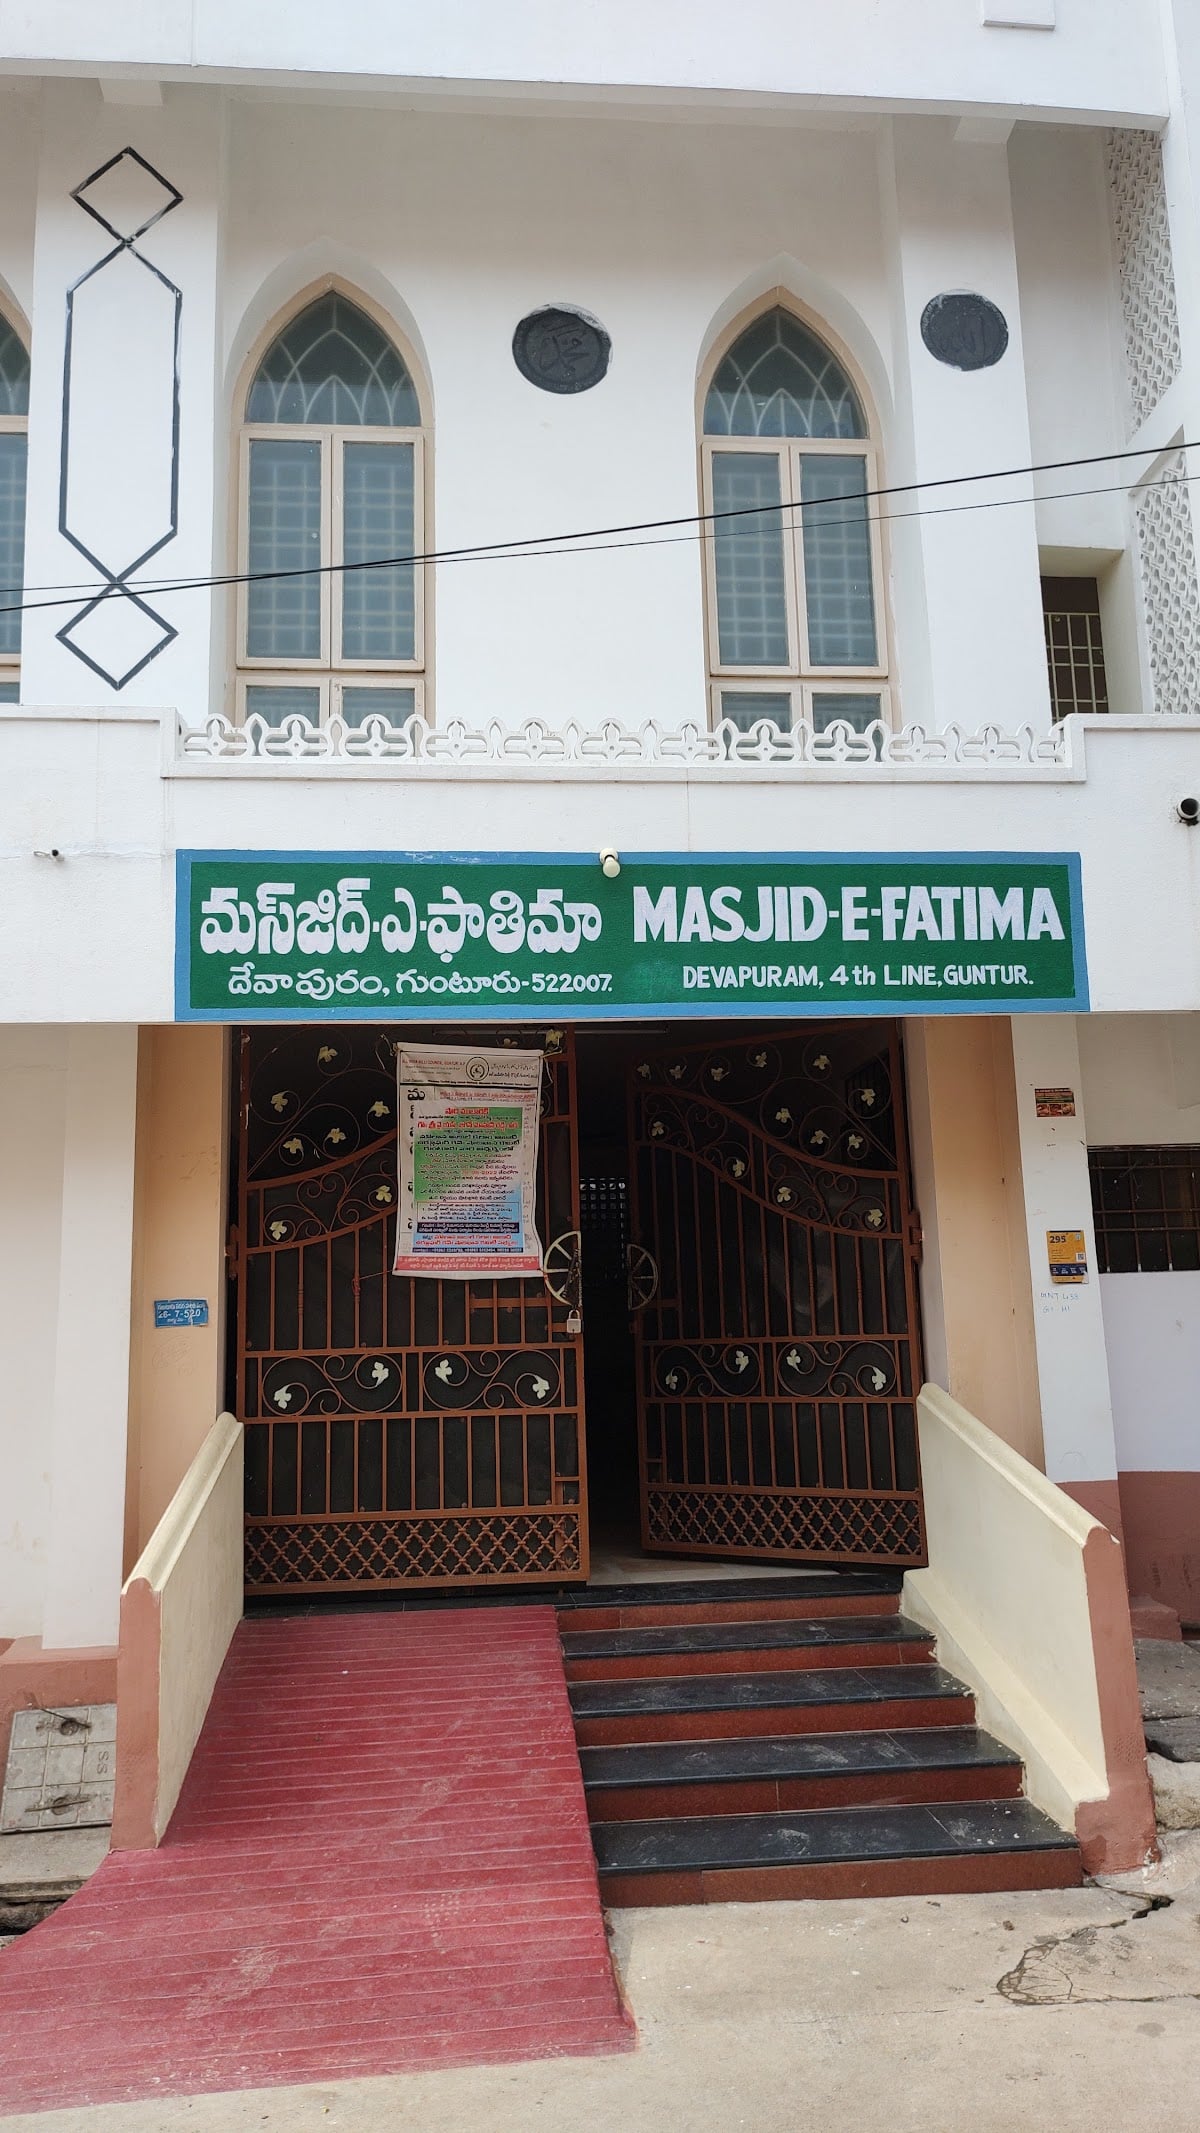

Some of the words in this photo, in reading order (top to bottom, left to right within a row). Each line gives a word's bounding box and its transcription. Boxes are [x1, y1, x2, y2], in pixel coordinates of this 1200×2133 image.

[633, 885, 1066, 943] MASJID-E-FATIMA
[682, 965, 824, 989] DEVAPURAM,
[1049, 1235, 1067, 1244] 295
